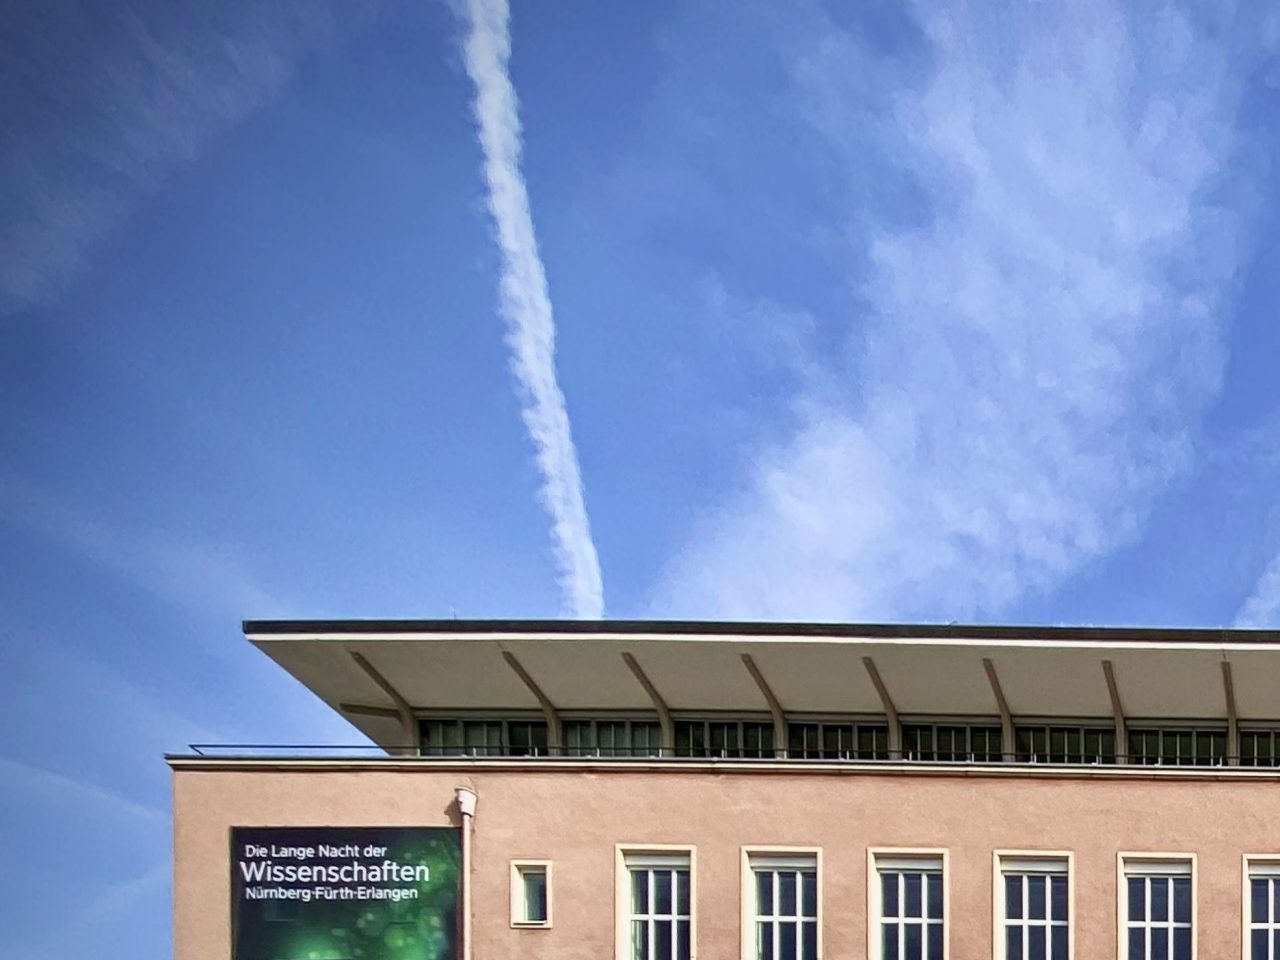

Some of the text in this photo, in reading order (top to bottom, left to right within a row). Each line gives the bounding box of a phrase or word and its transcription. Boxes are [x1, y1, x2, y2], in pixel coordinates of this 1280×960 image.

[245, 845, 387, 860] Die Lange Nacht der
[240, 860, 430, 882] Wissenschaften
